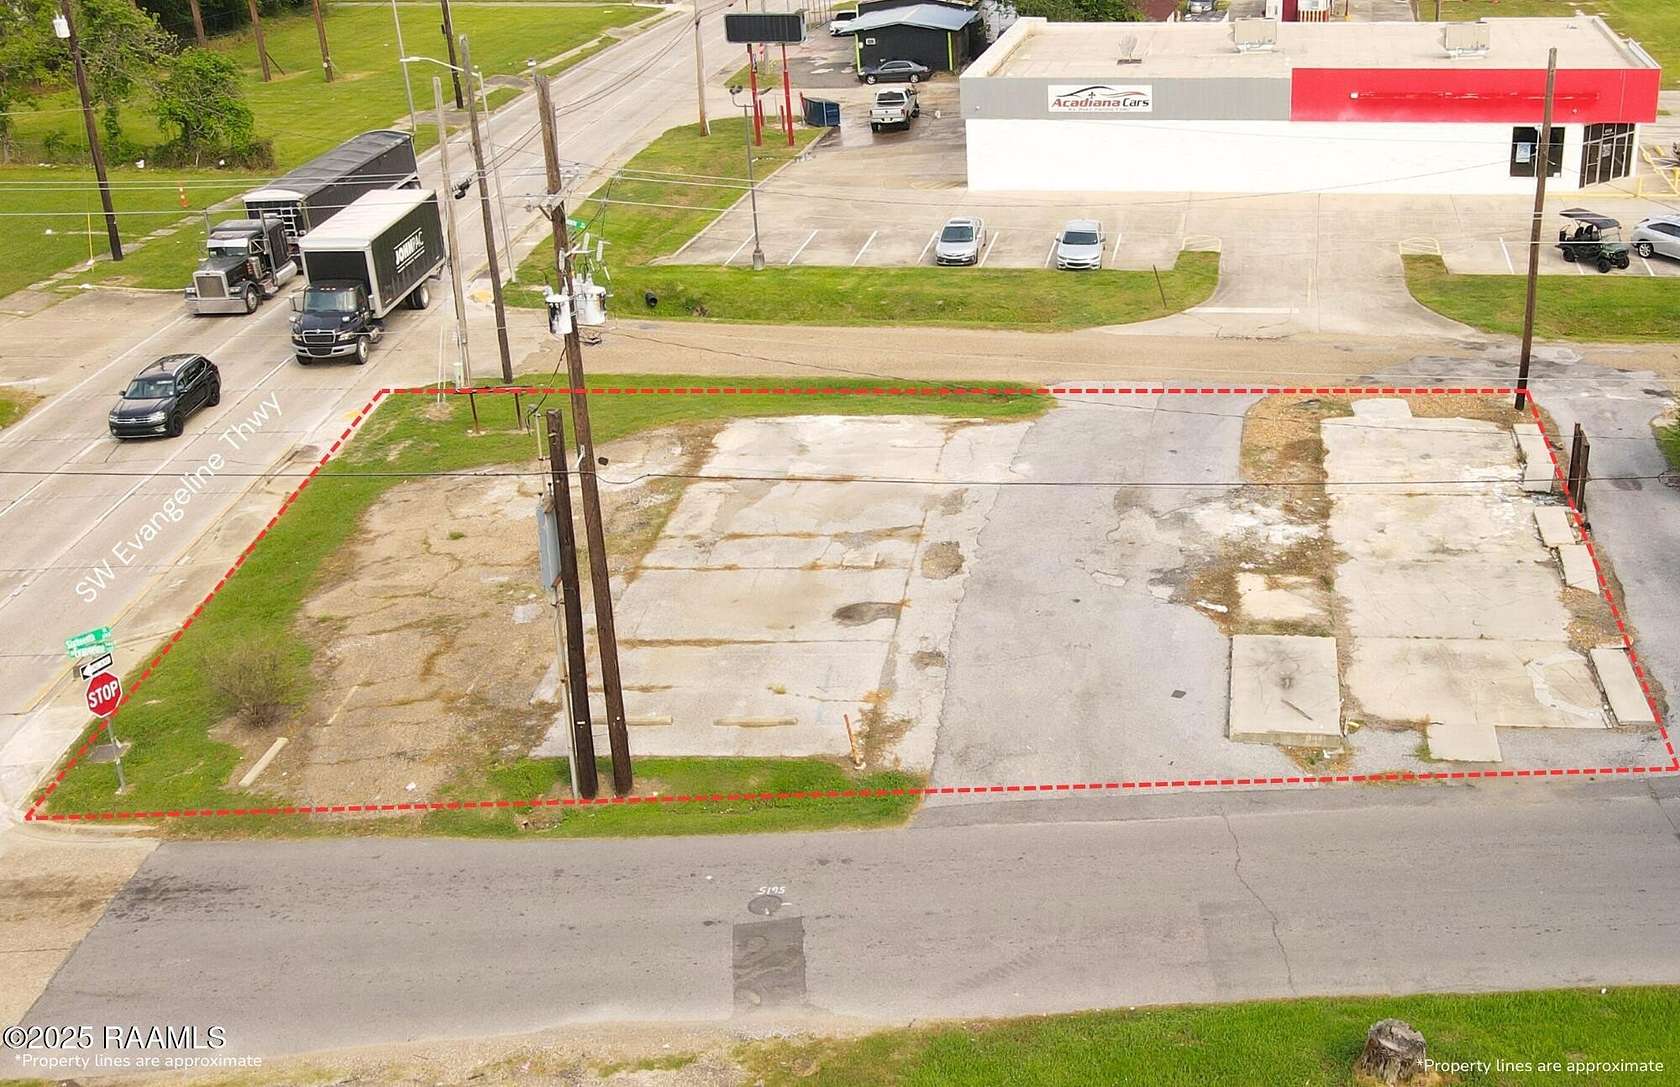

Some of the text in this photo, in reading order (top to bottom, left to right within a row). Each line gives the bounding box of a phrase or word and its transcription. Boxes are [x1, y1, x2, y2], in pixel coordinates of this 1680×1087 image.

[1051, 97, 1149, 107] Acadiana Cars
[88, 680, 118, 708] STOP
